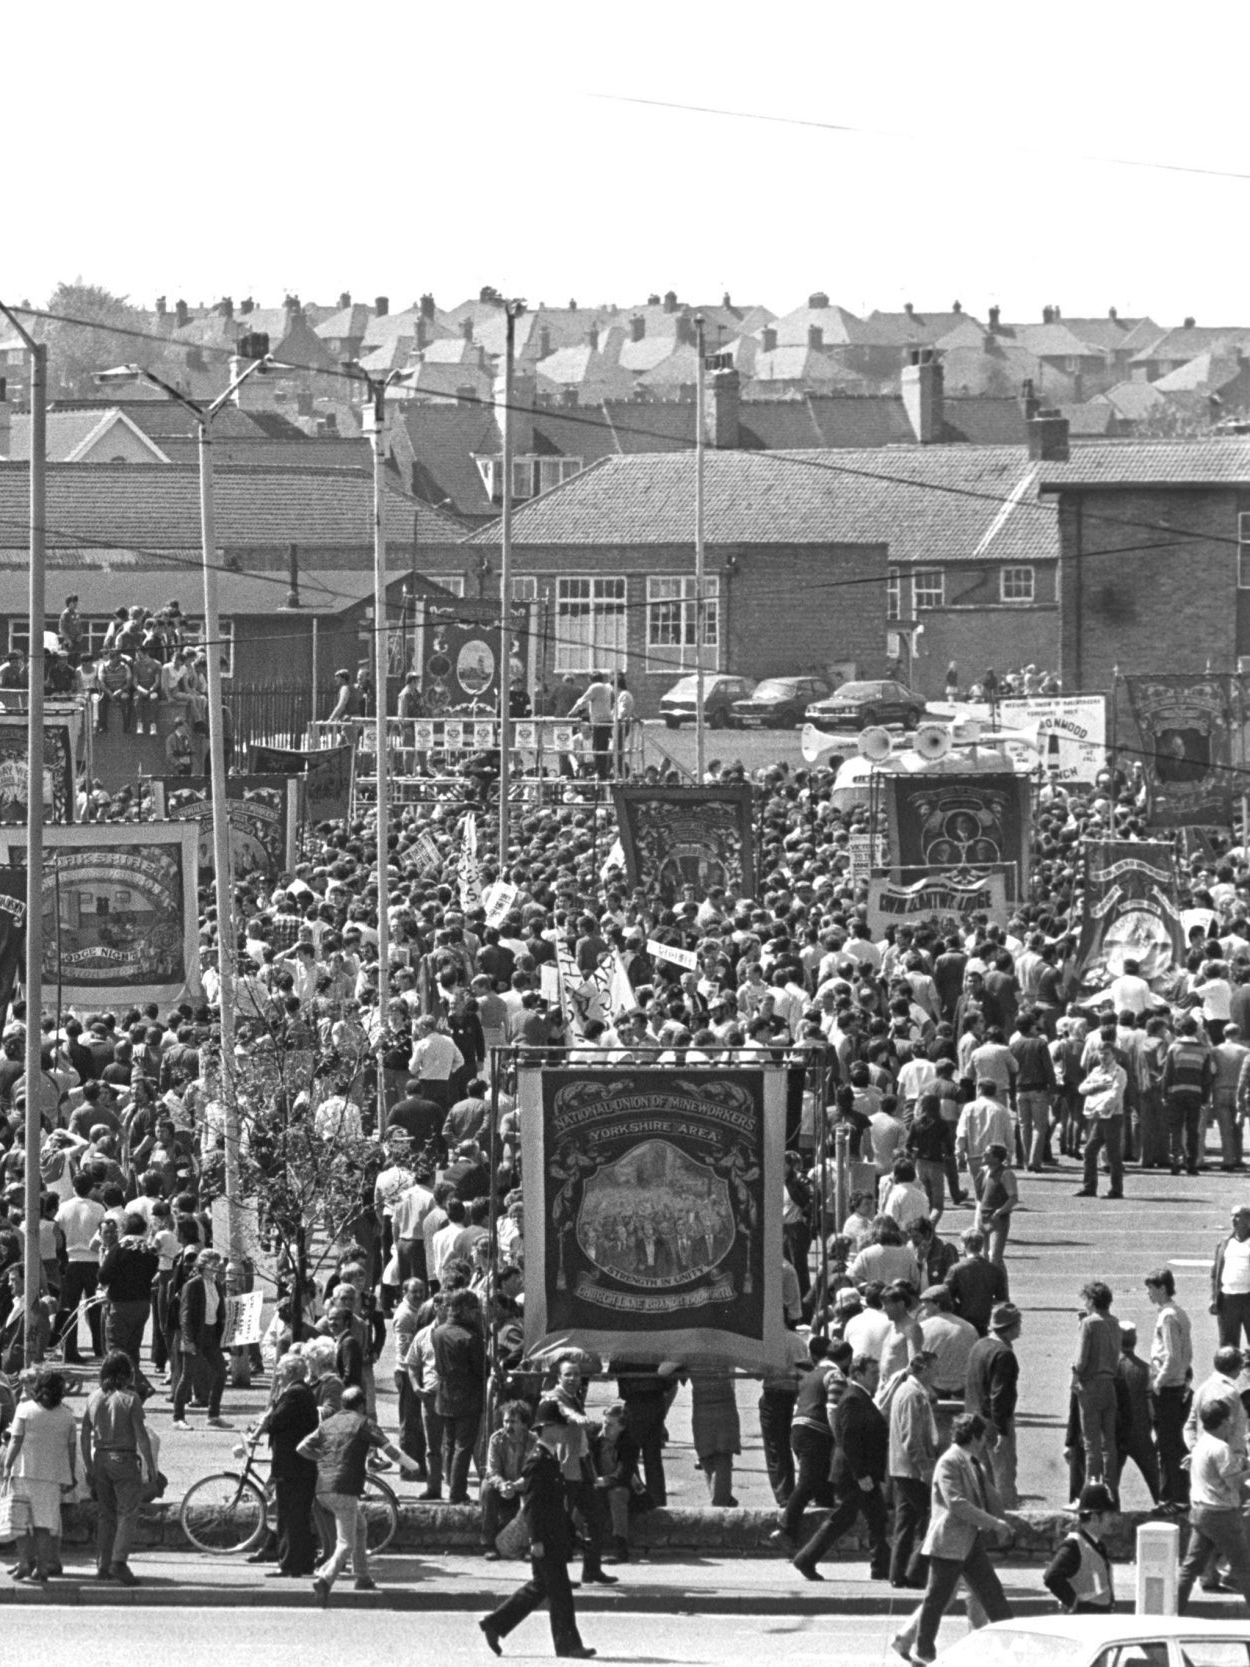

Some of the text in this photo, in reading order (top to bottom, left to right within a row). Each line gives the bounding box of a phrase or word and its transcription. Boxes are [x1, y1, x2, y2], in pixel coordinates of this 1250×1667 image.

[65, 947, 96, 962] ODGE
[553, 1094, 757, 1131] NATIONAL UNION OF MINEWORKERS
[589, 1120, 719, 1142] YORKSHIRE AREA
[607, 1264, 705, 1286] STRENGTH IN UNITY
[578, 1285, 617, 1306] CHURCH
[617, 1297, 644, 1309] LANE
[645, 1297, 684, 1310] BRANCH
